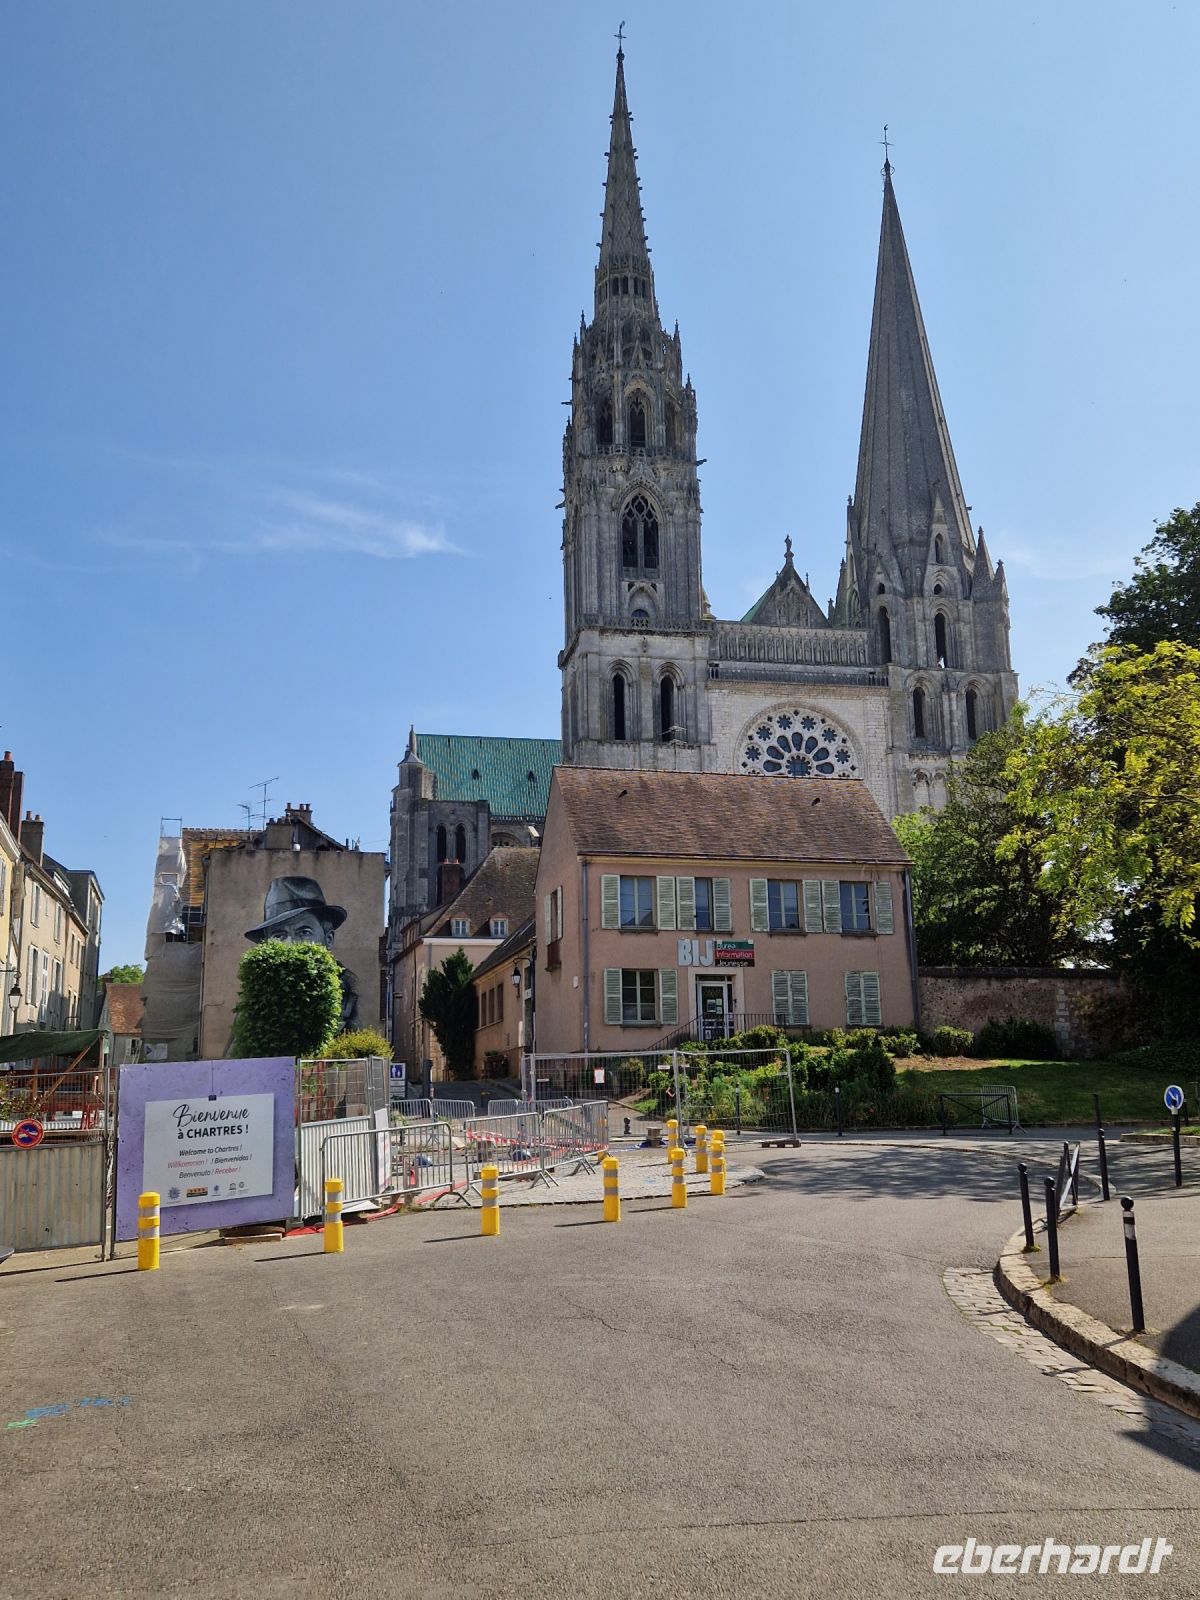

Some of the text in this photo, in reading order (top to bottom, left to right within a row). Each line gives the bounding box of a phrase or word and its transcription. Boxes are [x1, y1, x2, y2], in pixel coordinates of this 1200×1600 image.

[677, 939, 713, 967] BIJ
[716, 950, 753, 958] Information
[717, 959, 748, 967] Jeunesse
[173, 1104, 249, 1127] Bienvenue
[177, 1128, 184, 1140] à
[187, 1125, 243, 1138] CHARTRES
[179, 1148, 206, 1157] Welcome
[214, 1144, 239, 1154] Chartres
[167, 1160, 205, 1168] Willkommen
[179, 1169, 211, 1179] Benvenuto
